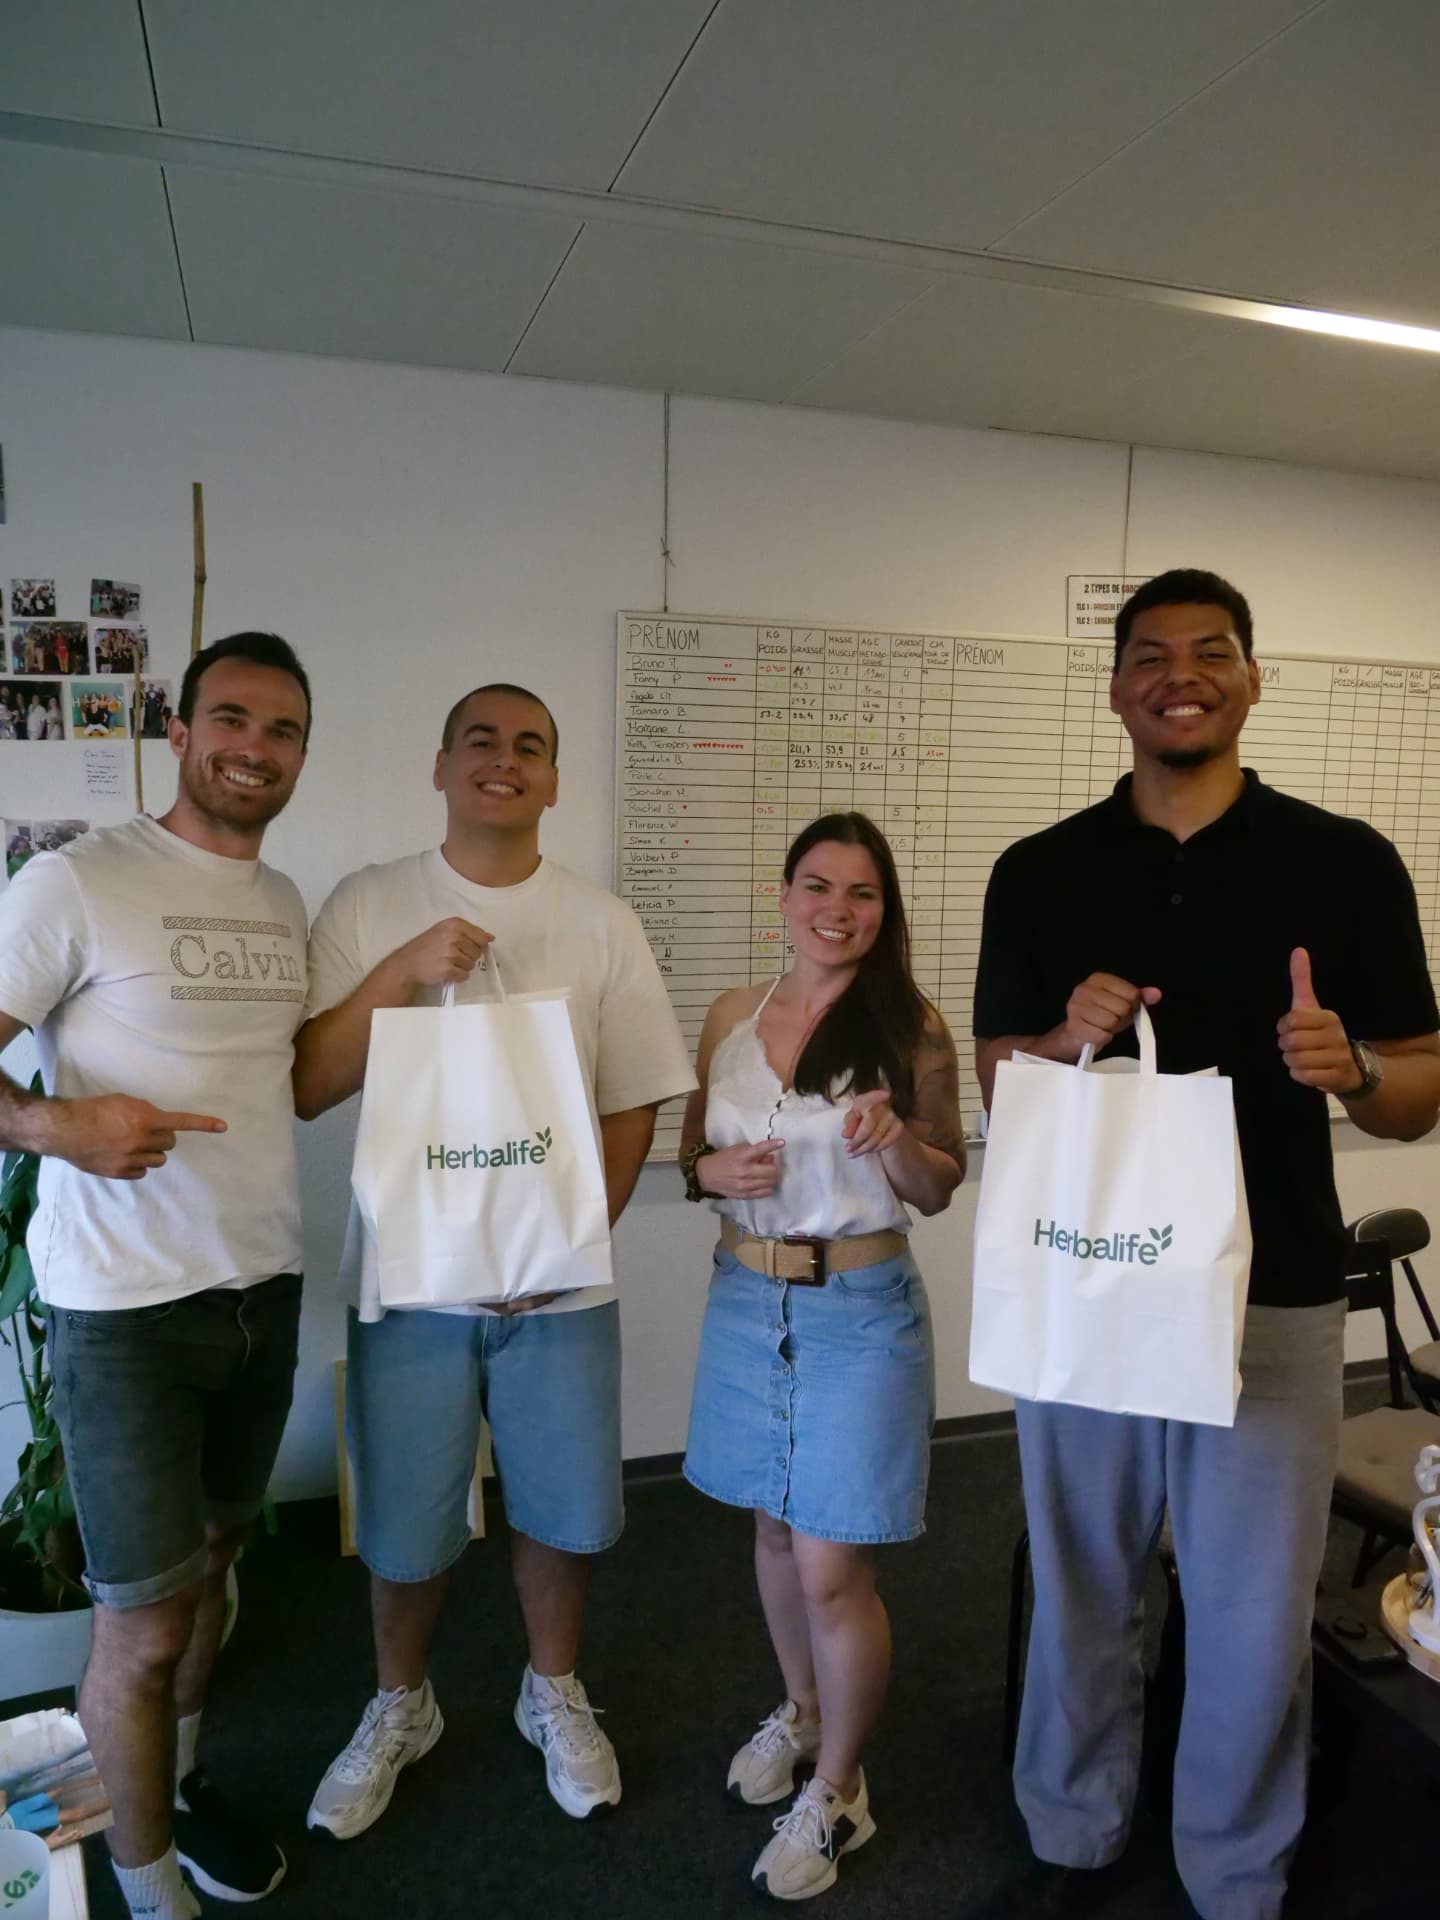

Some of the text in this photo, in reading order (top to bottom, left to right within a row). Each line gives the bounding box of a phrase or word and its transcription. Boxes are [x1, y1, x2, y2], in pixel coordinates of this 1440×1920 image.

[1083, 584, 1091, 594] 2
[1091, 584, 1111, 594] TYPES
[1111, 584, 1121, 594] DE
[629, 621, 701, 650] PRÉNOM
[766, 630, 780, 640] KG
[829, 635, 854, 645] MASSE
[758, 643, 788, 654] POIDS
[791, 645, 825, 655] GRAISSE
[828, 648, 858, 658] MUSCLE
[956, 642, 1004, 667] PRÉNOM
[1072, 648, 1085, 658] KG
[631, 655, 666, 670] Bruno
[1069, 660, 1096, 673] POIDS
[630, 705, 670, 717] Tamara
[628, 819, 665, 831] Florence
[171, 934, 303, 982] Calvin
[426, 1137, 547, 1171] Herbalife
[1033, 1216, 1160, 1266] Herbalife
